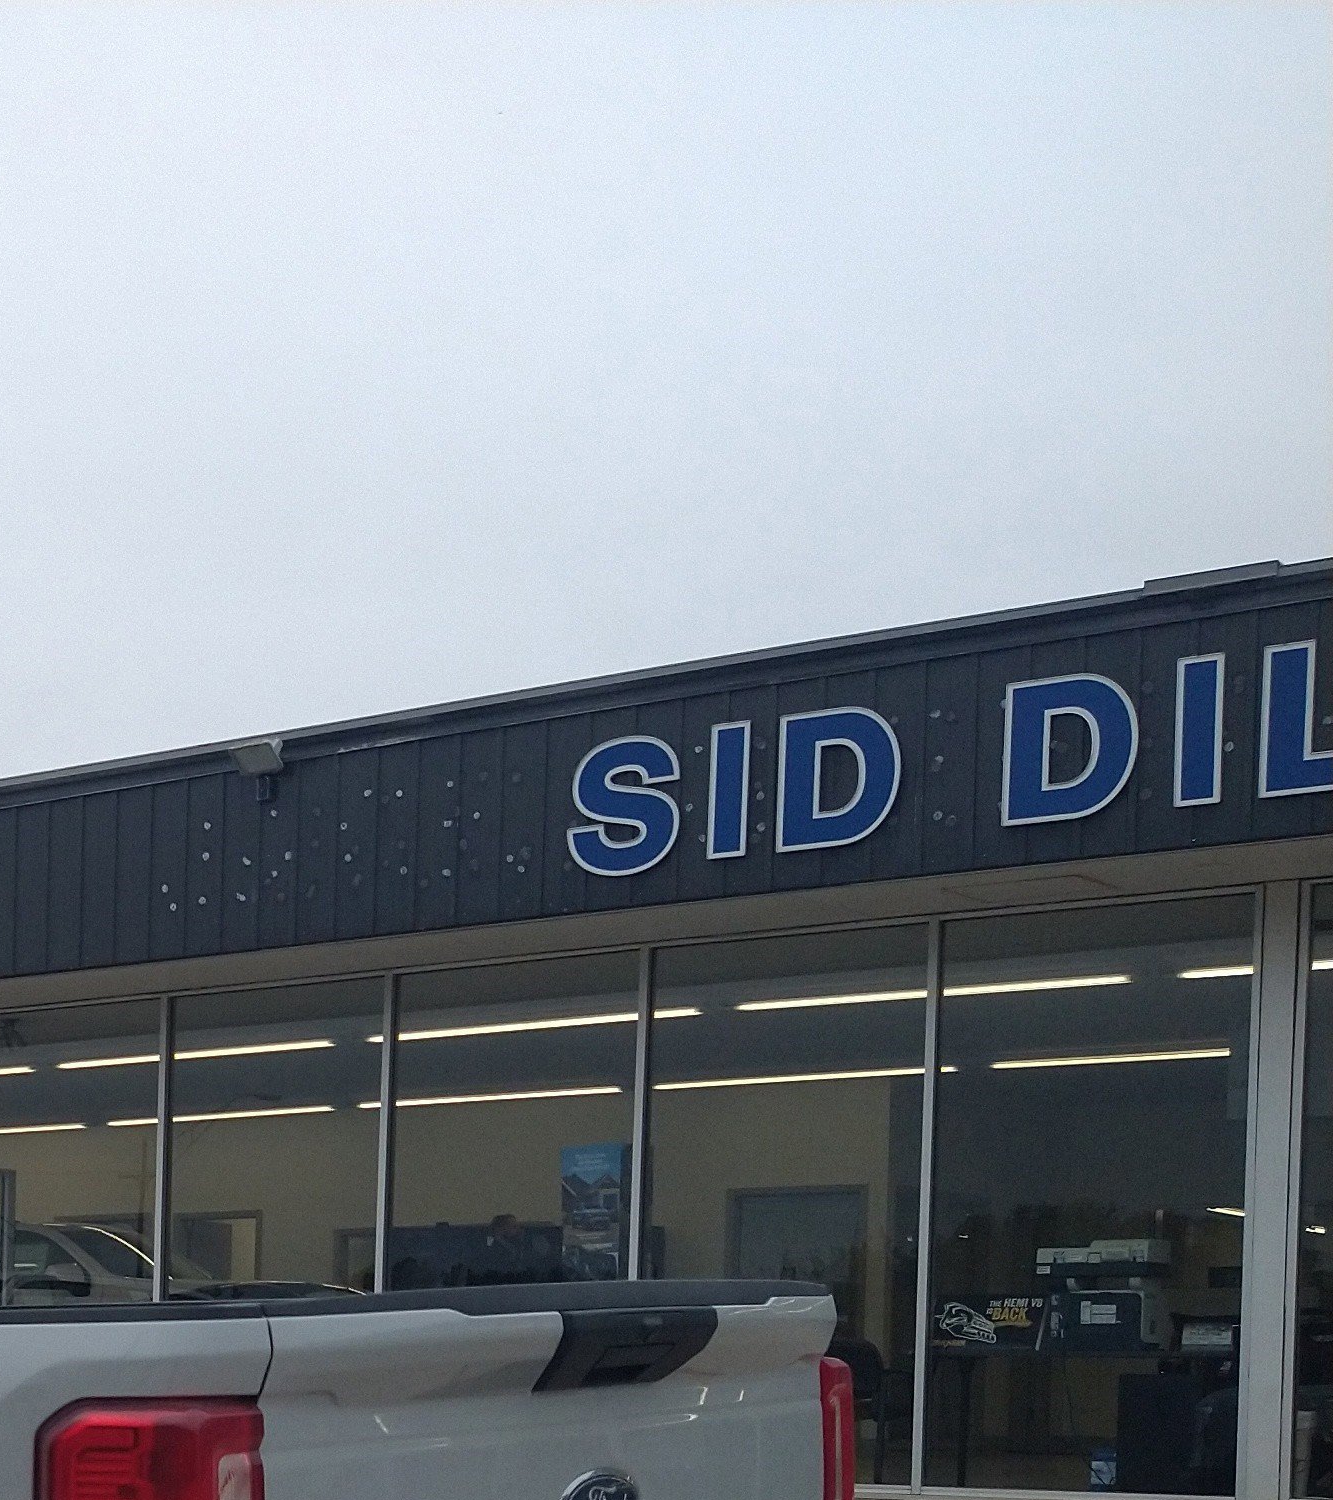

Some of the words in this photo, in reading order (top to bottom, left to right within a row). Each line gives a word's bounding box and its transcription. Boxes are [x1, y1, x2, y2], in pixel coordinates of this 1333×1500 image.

[567, 707, 901, 876] SID
[1000, 639, 1333, 827] DIL
[1003, 1298, 1028, 1307] HEMI
[992, 1307, 1028, 1320] BACK
